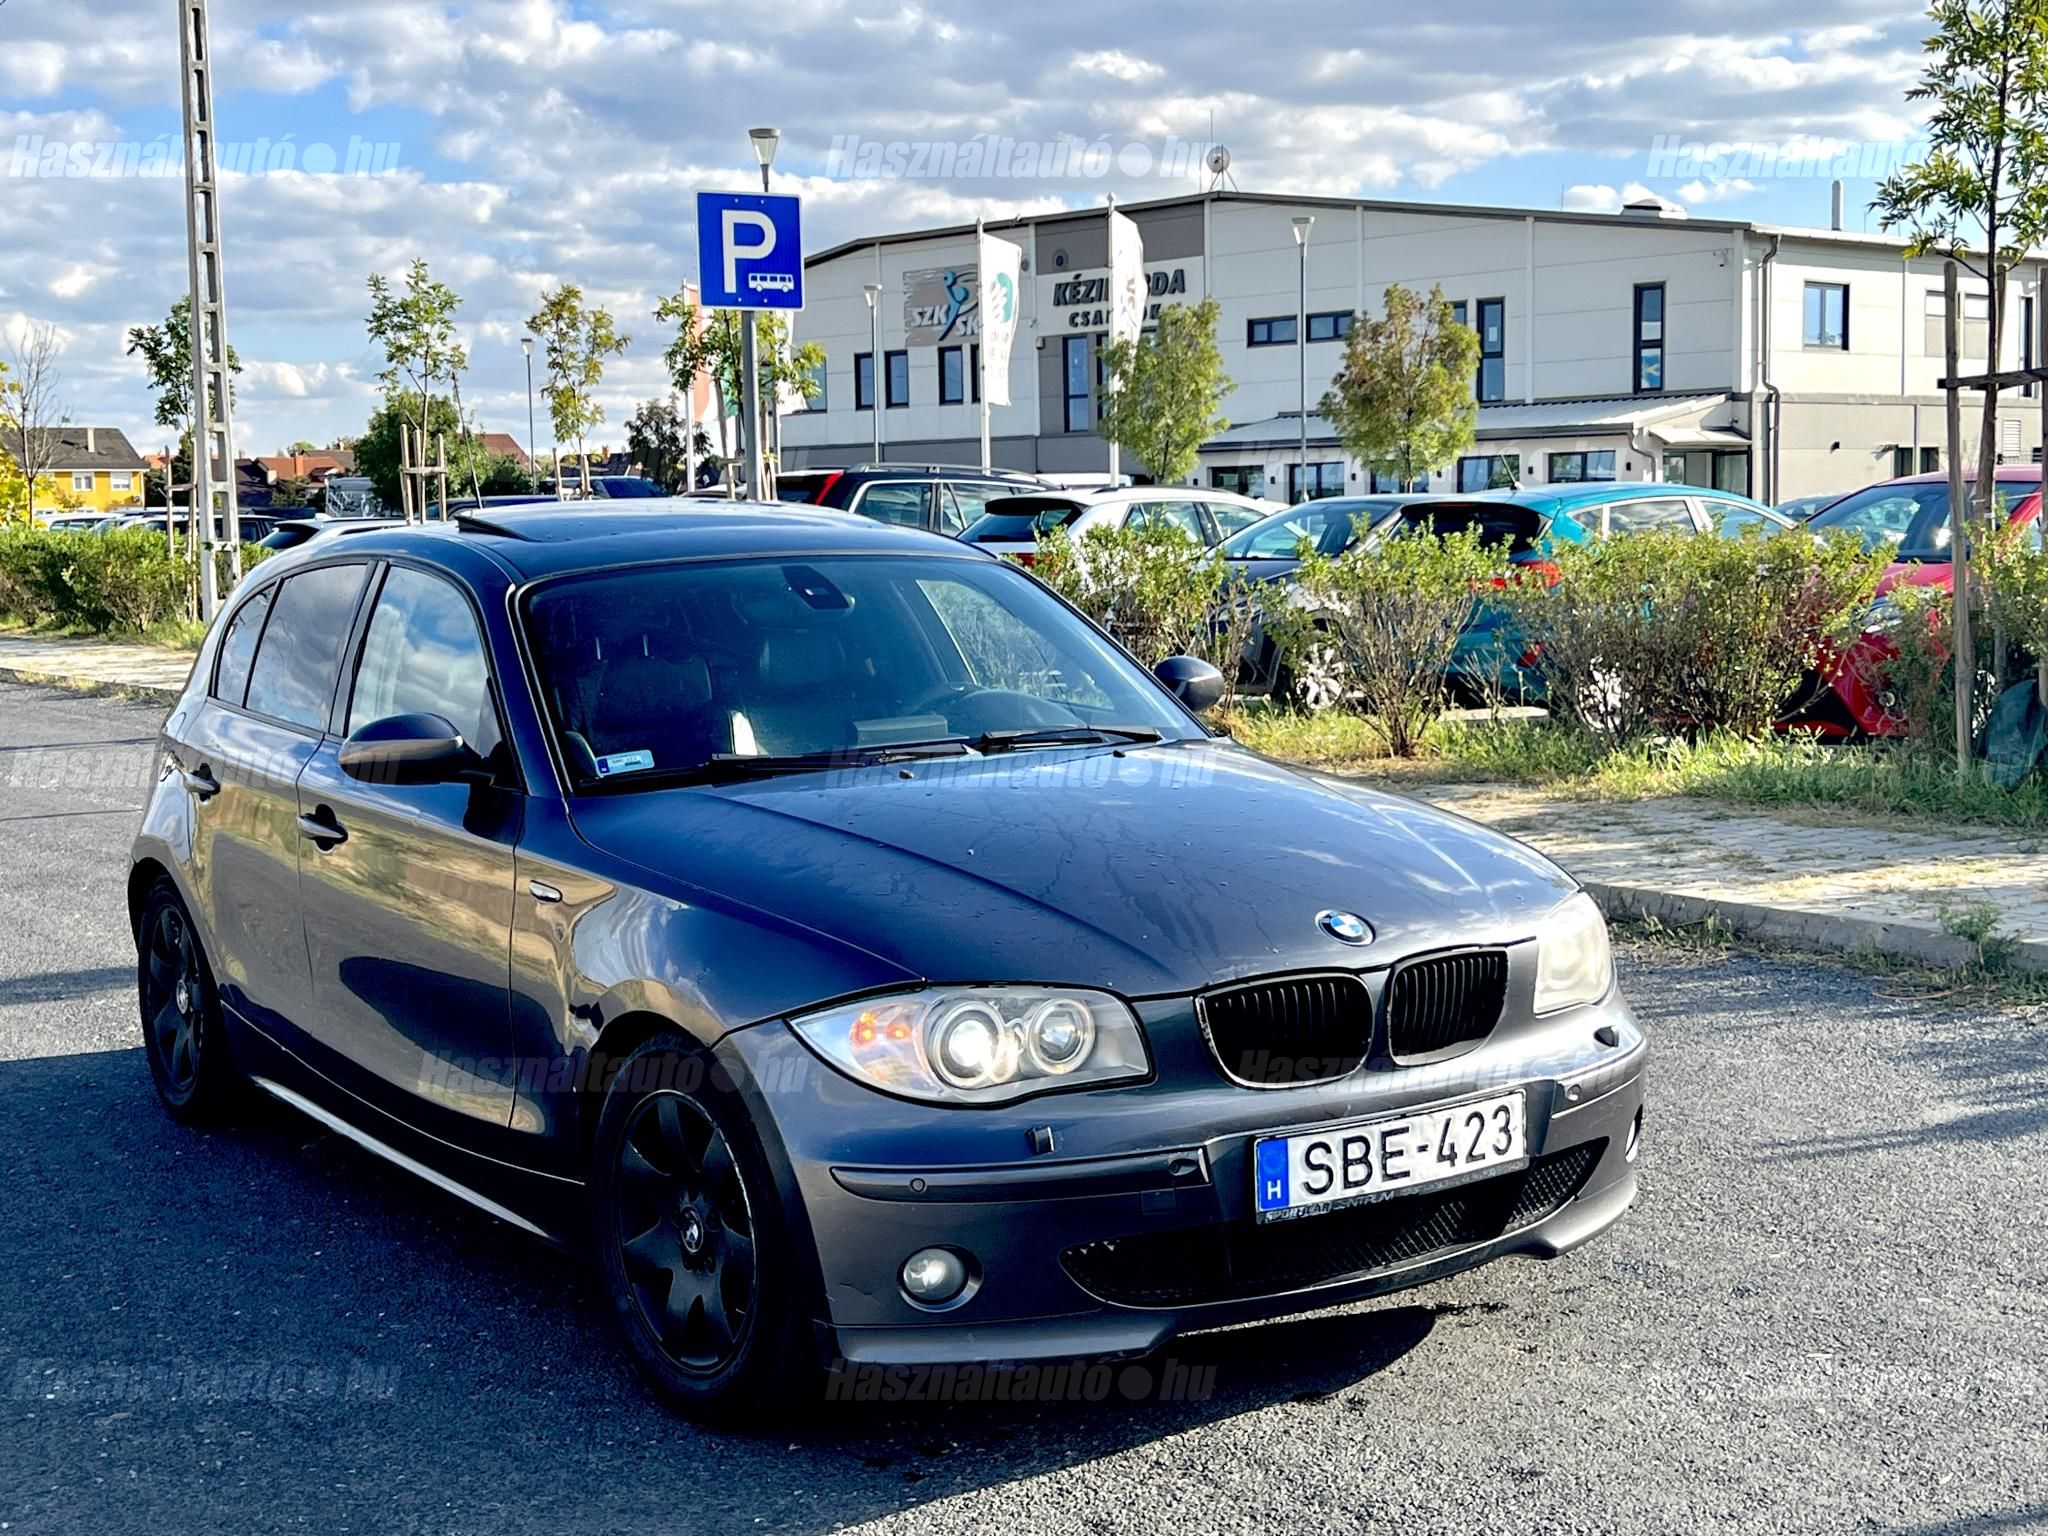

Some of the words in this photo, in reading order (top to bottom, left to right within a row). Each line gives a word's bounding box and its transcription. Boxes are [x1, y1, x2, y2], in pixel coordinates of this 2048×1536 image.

[722, 209, 777, 294] P
[910, 304, 948, 327] SZK
[1302, 1104, 1513, 1195] SBE-423
[1267, 1180, 1282, 1200] H
